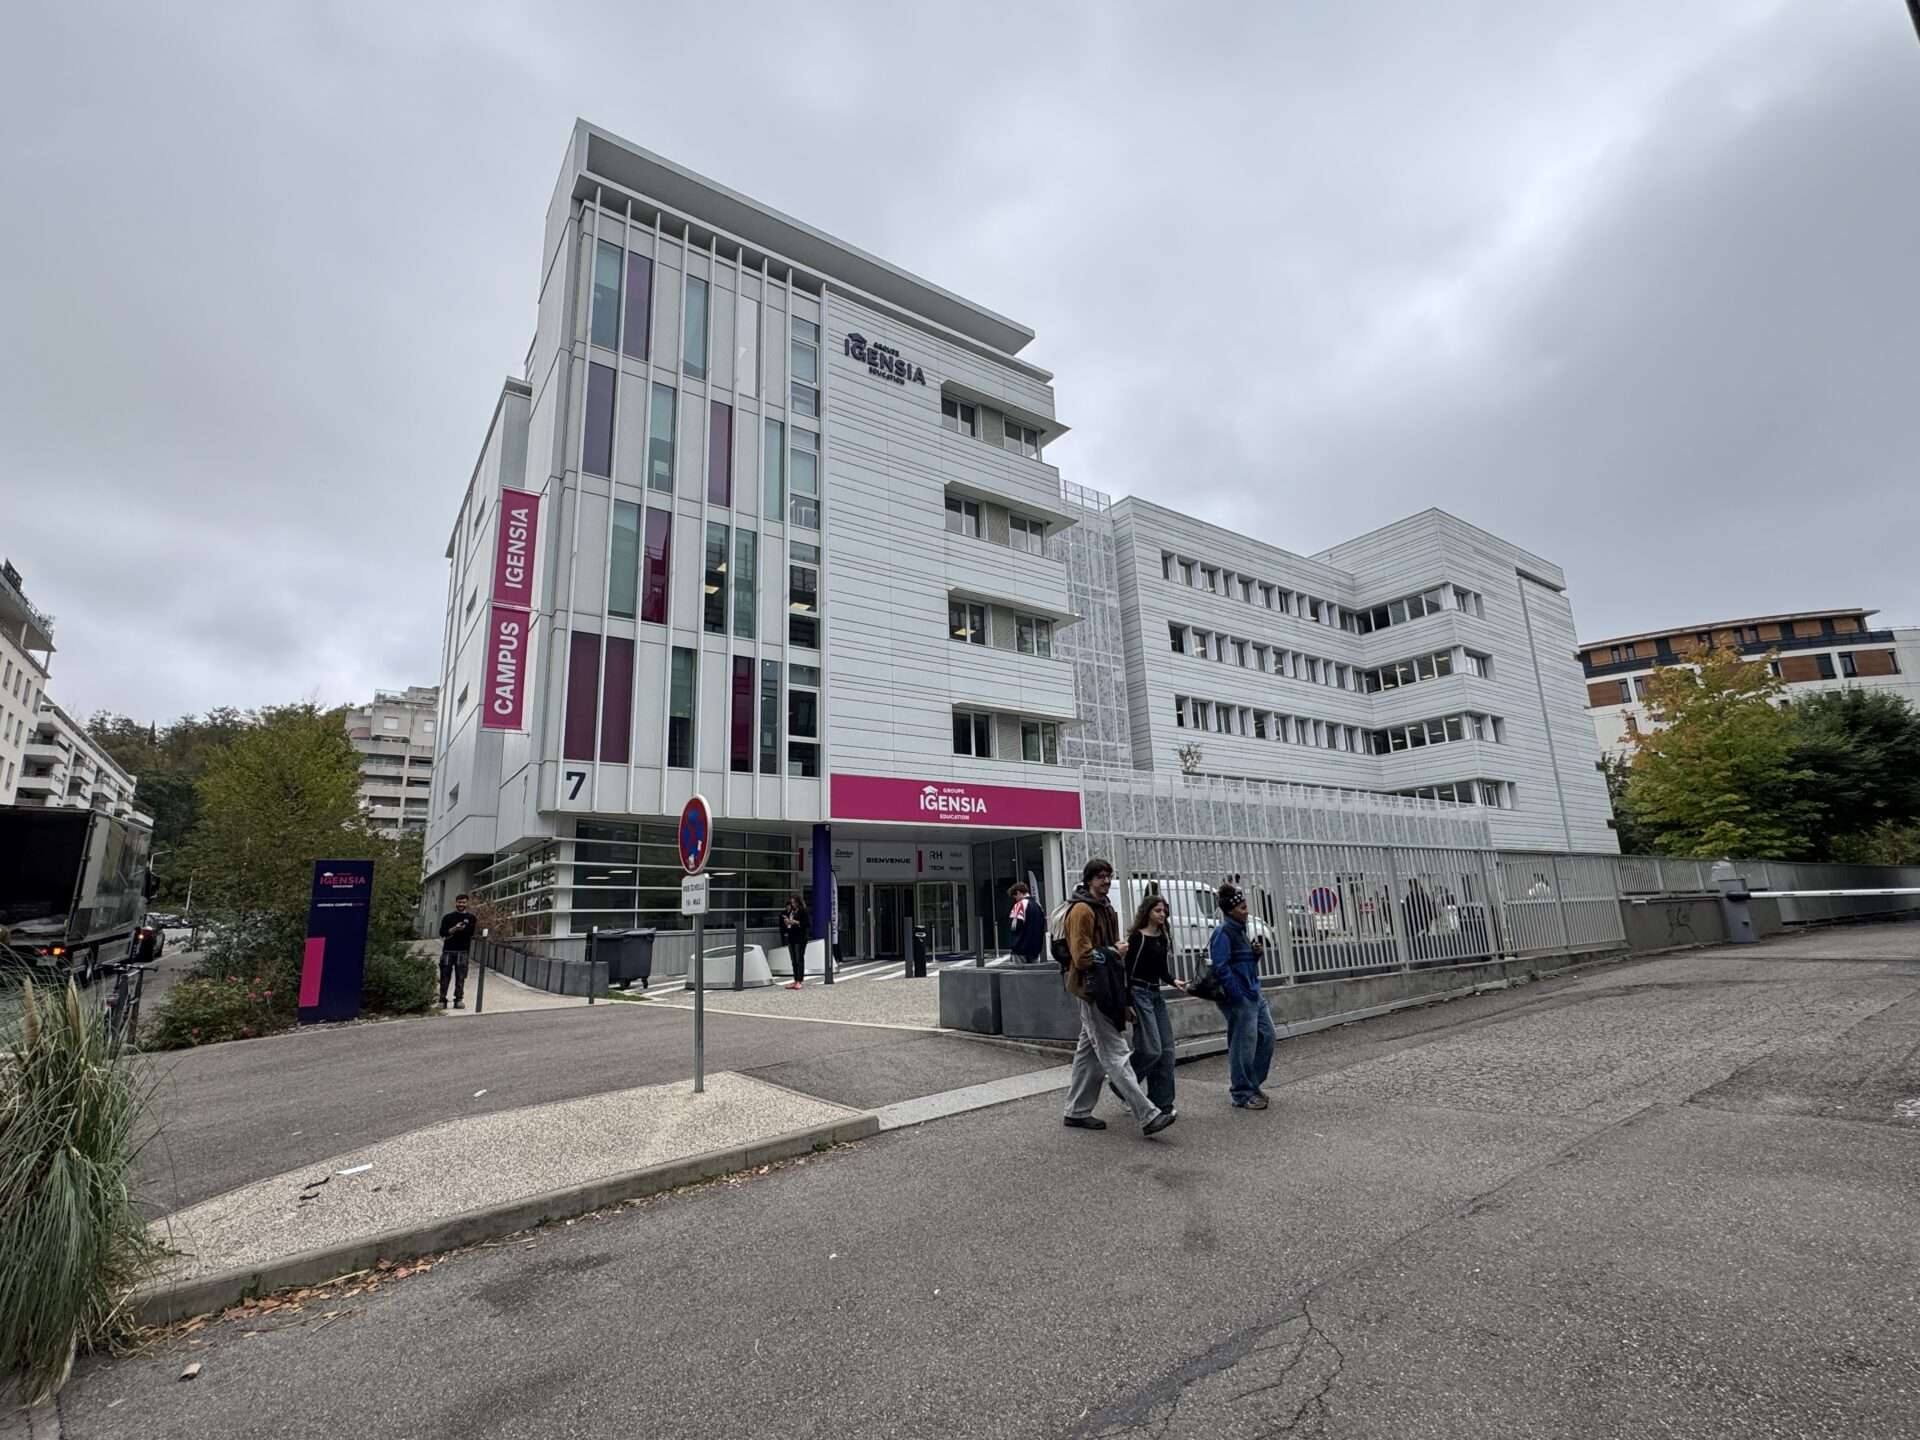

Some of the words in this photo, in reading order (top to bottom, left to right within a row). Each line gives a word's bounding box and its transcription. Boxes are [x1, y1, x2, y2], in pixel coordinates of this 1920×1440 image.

[844, 338, 926, 386] IGENSIA
[504, 508, 529, 589] IGENSIA
[494, 621, 520, 715] CAMPUS
[565, 771, 586, 801] 7
[920, 794, 988, 813] IGENSIA
[320, 876, 366, 884] IGENSIA
